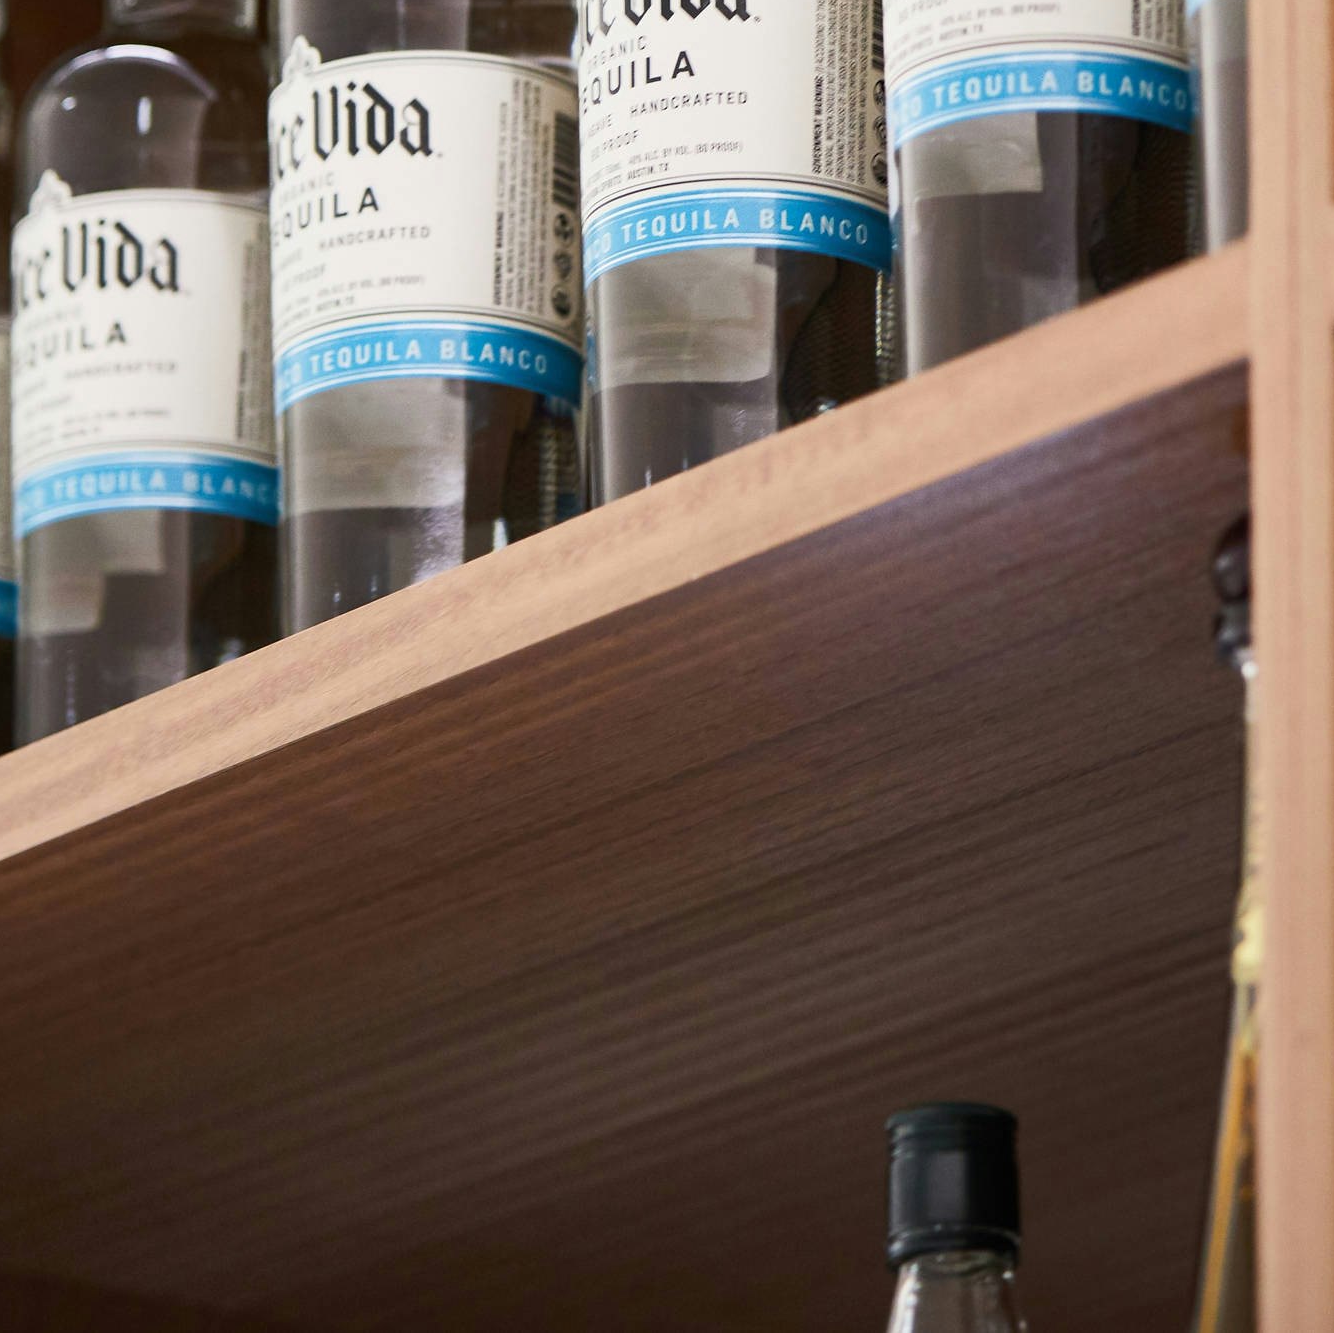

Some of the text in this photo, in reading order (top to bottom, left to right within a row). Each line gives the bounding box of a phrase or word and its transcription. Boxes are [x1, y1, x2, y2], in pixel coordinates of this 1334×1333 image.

[582, 50, 695, 114] EQUILA
[932, 70, 1187, 111] TEQUILA BLANCO
[312, 81, 432, 161] Vida
[630, 91, 748, 118] HANDCRAFTED
[274, 186, 379, 247] EQUILA
[621, 207, 740, 244] TEQUILA
[758, 208, 868, 245] BLANCO
[61, 219, 179, 293] Vida
[319, 225, 431, 250] HANDCRAFTED
[309, 338, 547, 374] TEQUILA BLANCO
[182, 470, 279, 505] BLANC
